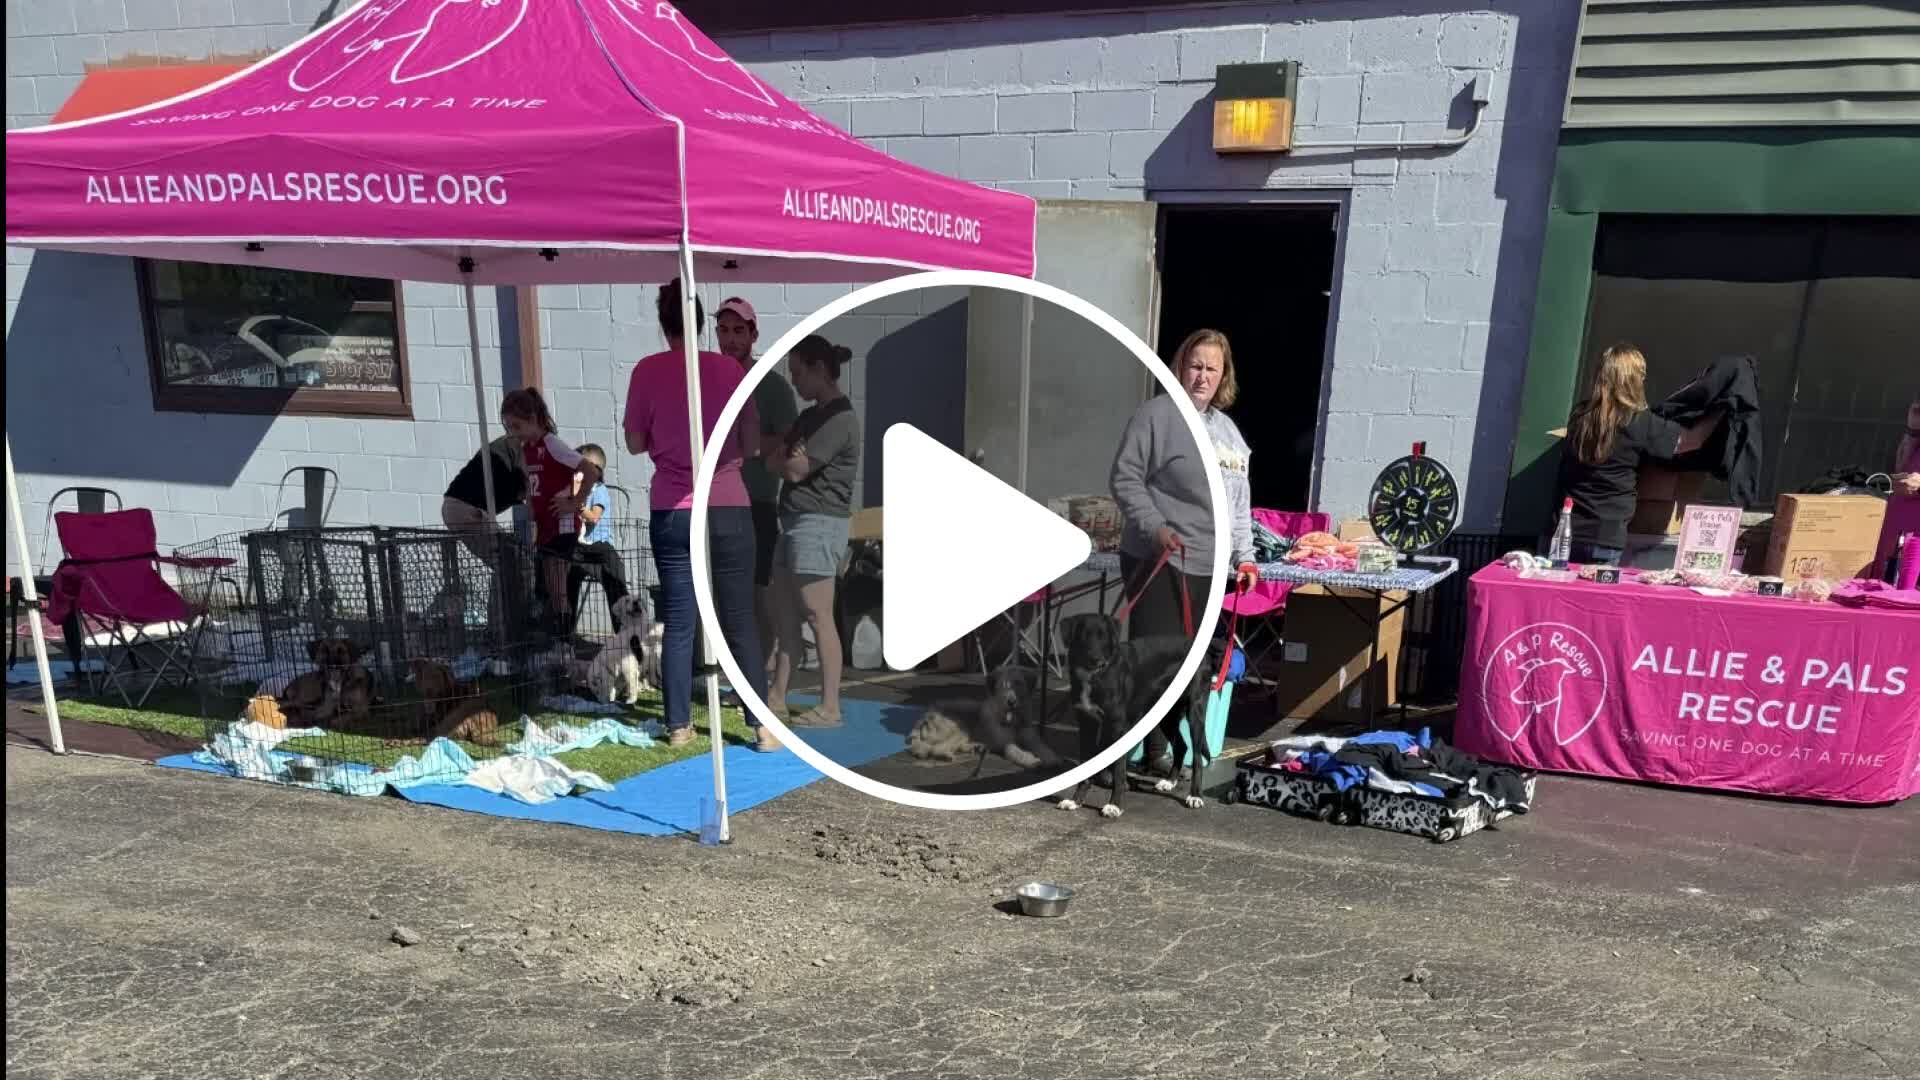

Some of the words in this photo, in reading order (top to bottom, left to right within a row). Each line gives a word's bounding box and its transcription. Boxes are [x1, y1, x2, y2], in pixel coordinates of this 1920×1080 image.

[241, 100, 304, 116] ONE
[308, 96, 380, 109] DOG
[384, 97, 431, 109] AT
[432, 97, 455, 109] A
[469, 97, 548, 109] TIME
[86, 172, 508, 207] ALLIEANDPALSRESCUE.ORG
[782, 188, 982, 244] ALLIEANDPALSRESCUE.ORG
[1503, 649, 1517, 666] A
[1517, 641, 1530, 656] &
[1532, 633, 1542, 651] P
[1550, 631, 1593, 678] Rescue
[1631, 644, 1749, 681] ALLIE
[1760, 655, 1787, 685] &
[1801, 658, 1909, 696] PALS
[1677, 691, 1842, 735] RESCUE
[1619, 728, 1686, 748] SAVING
[1693, 736, 1734, 752] ONE
[1741, 742, 1783, 758] DOG
[1790, 747, 1812, 761] AT
[1818, 751, 1832, 763] A
[1839, 751, 1887, 769] TIME
